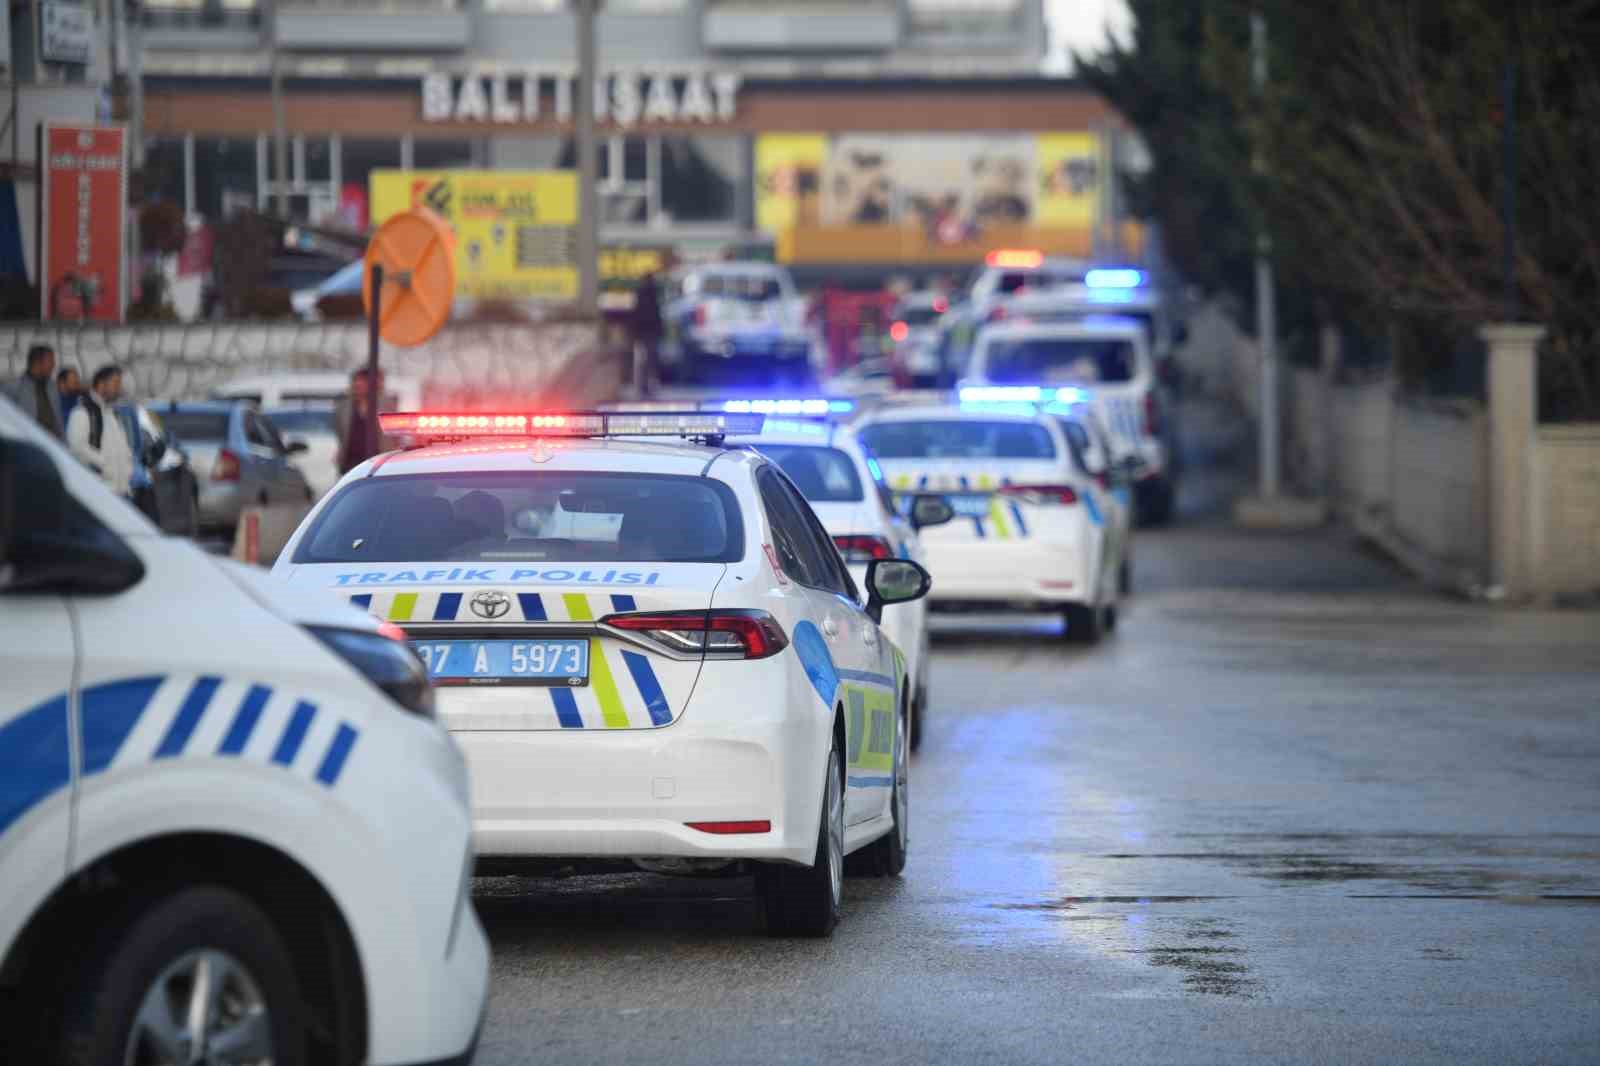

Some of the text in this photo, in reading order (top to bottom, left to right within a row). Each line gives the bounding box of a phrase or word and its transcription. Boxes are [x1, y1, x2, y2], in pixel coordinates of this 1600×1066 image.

[335, 568, 497, 584] TRAFİK
[473, 644, 489, 673] A
[511, 644, 581, 673] 5973
